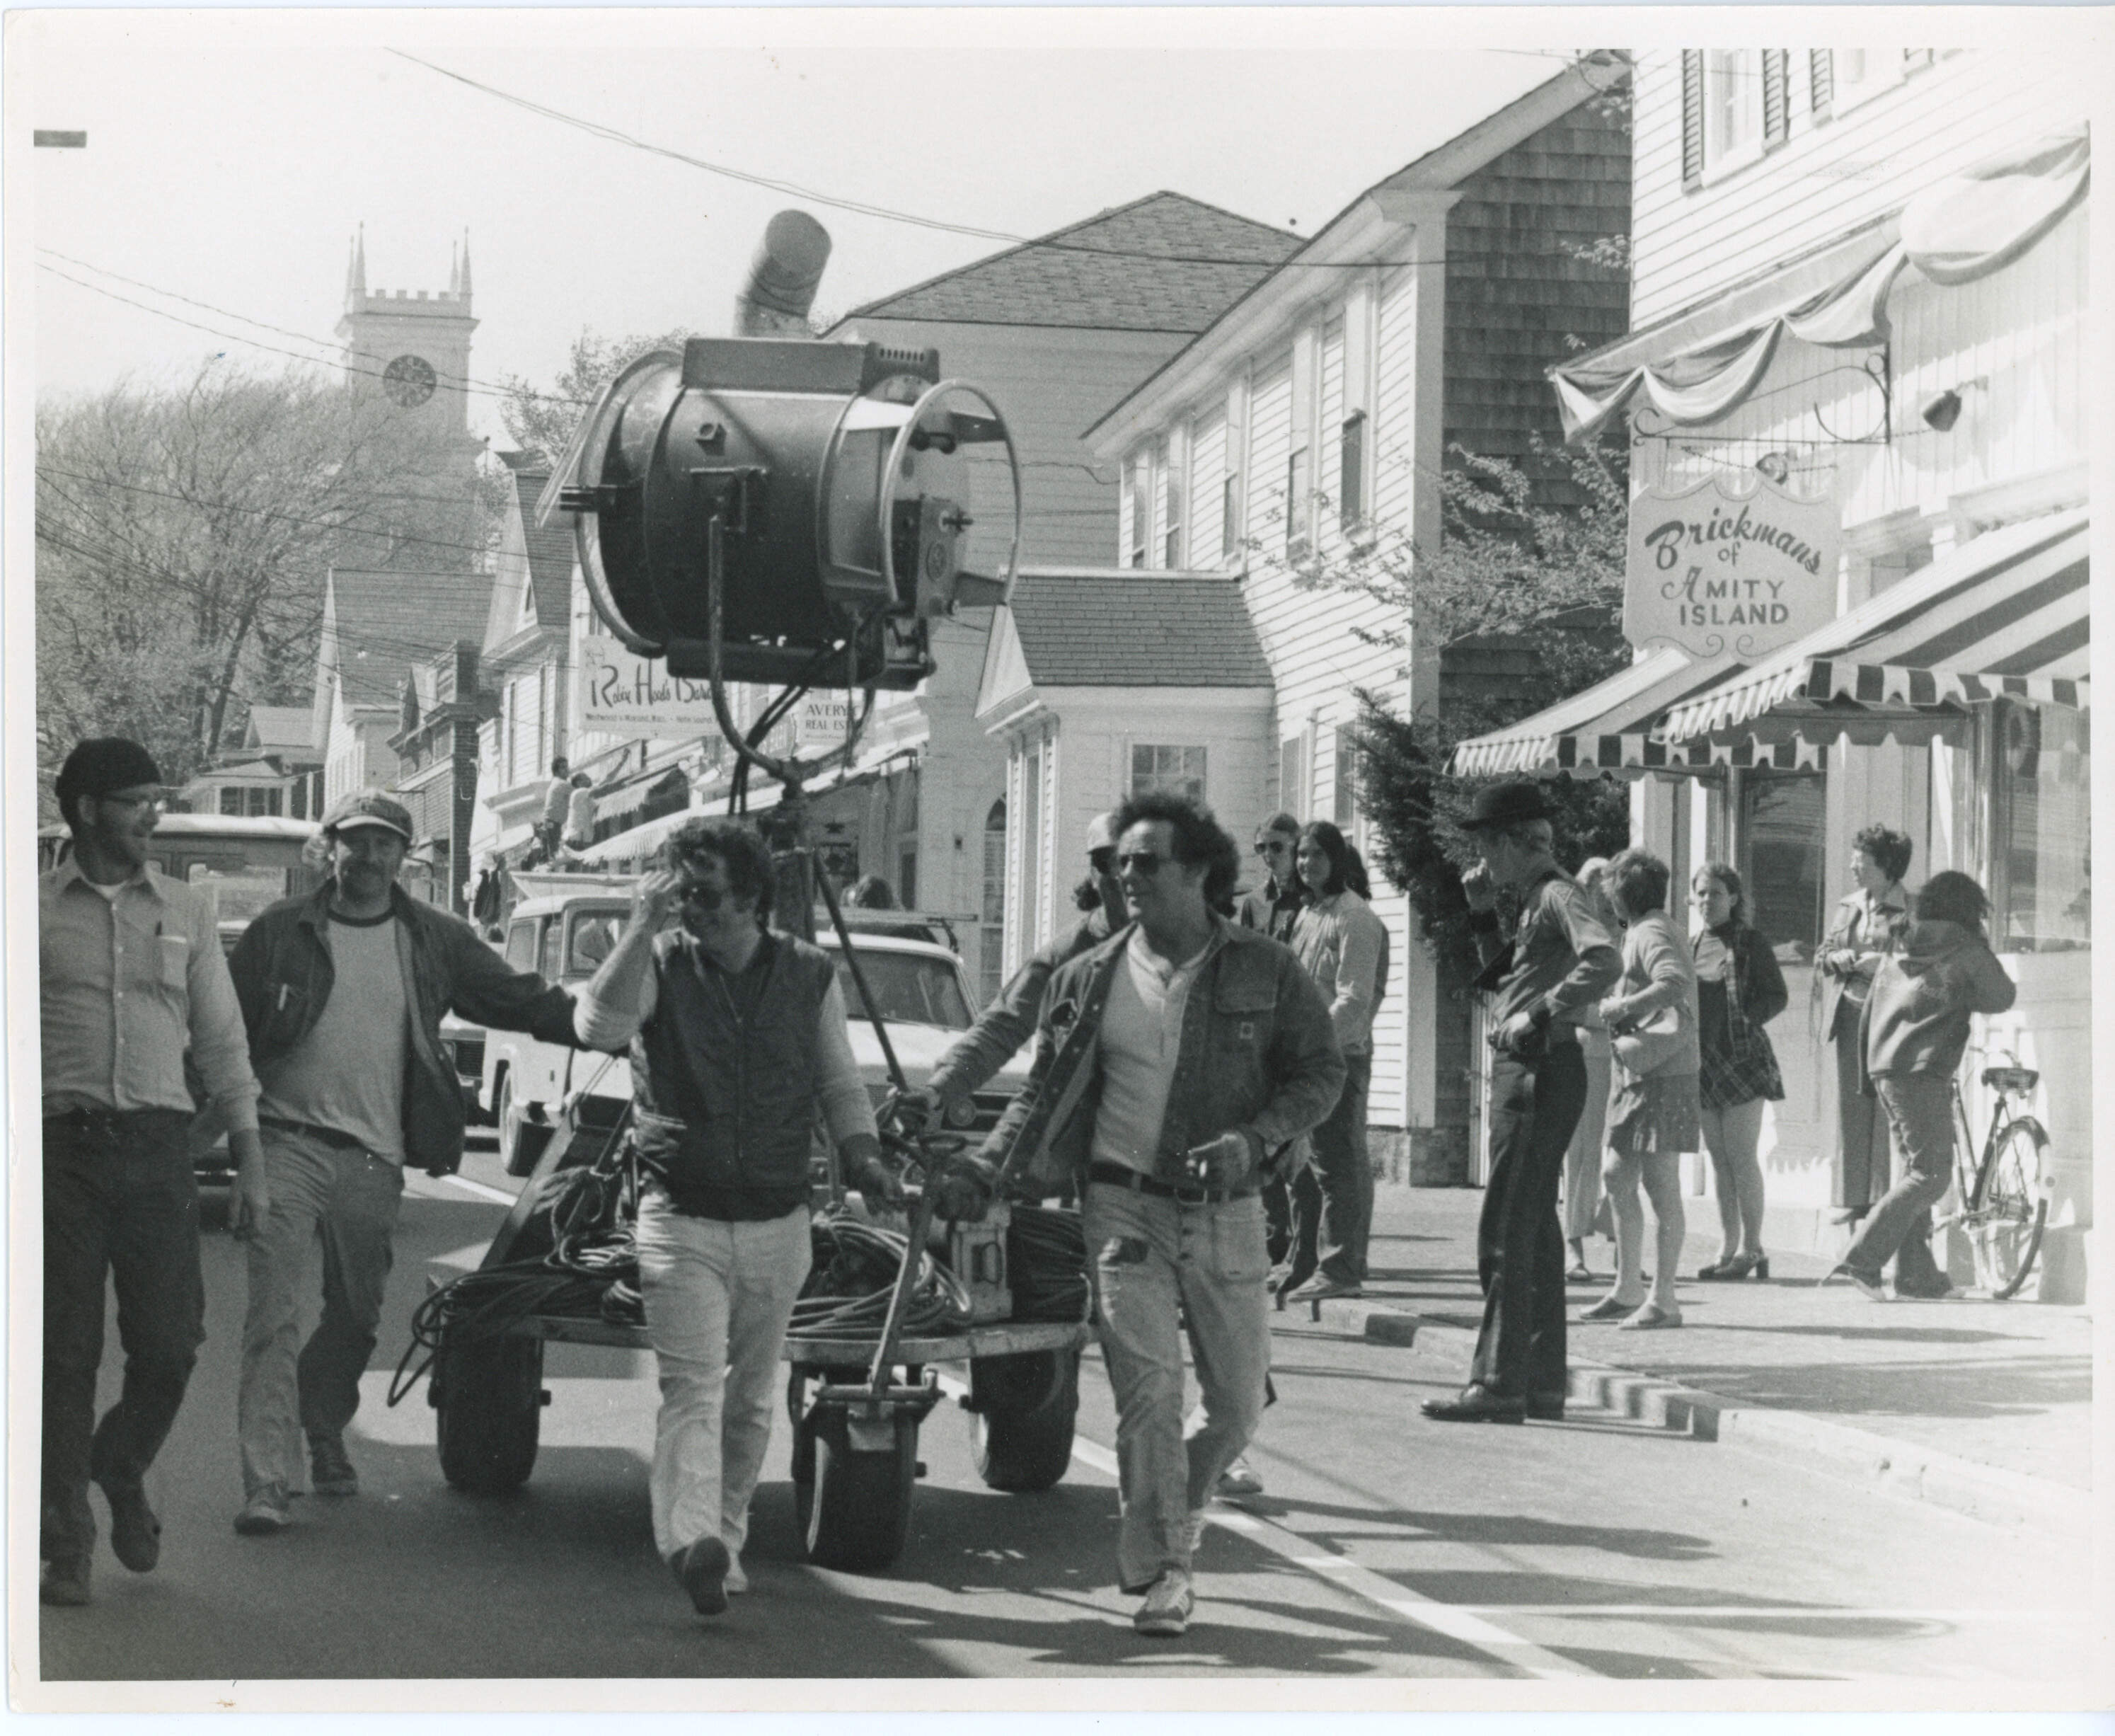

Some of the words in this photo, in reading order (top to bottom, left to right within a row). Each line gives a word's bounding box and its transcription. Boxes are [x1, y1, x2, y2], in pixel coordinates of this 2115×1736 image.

[1644, 504, 1821, 575] Brickmans
[1717, 541, 1741, 566] of
[1661, 566, 1785, 603] AMITY
[1680, 604, 1789, 626] ISLAND
[591, 665, 631, 708] Robin
[635, 659, 672, 706] Hood's
[807, 704, 848, 716] AVERY
